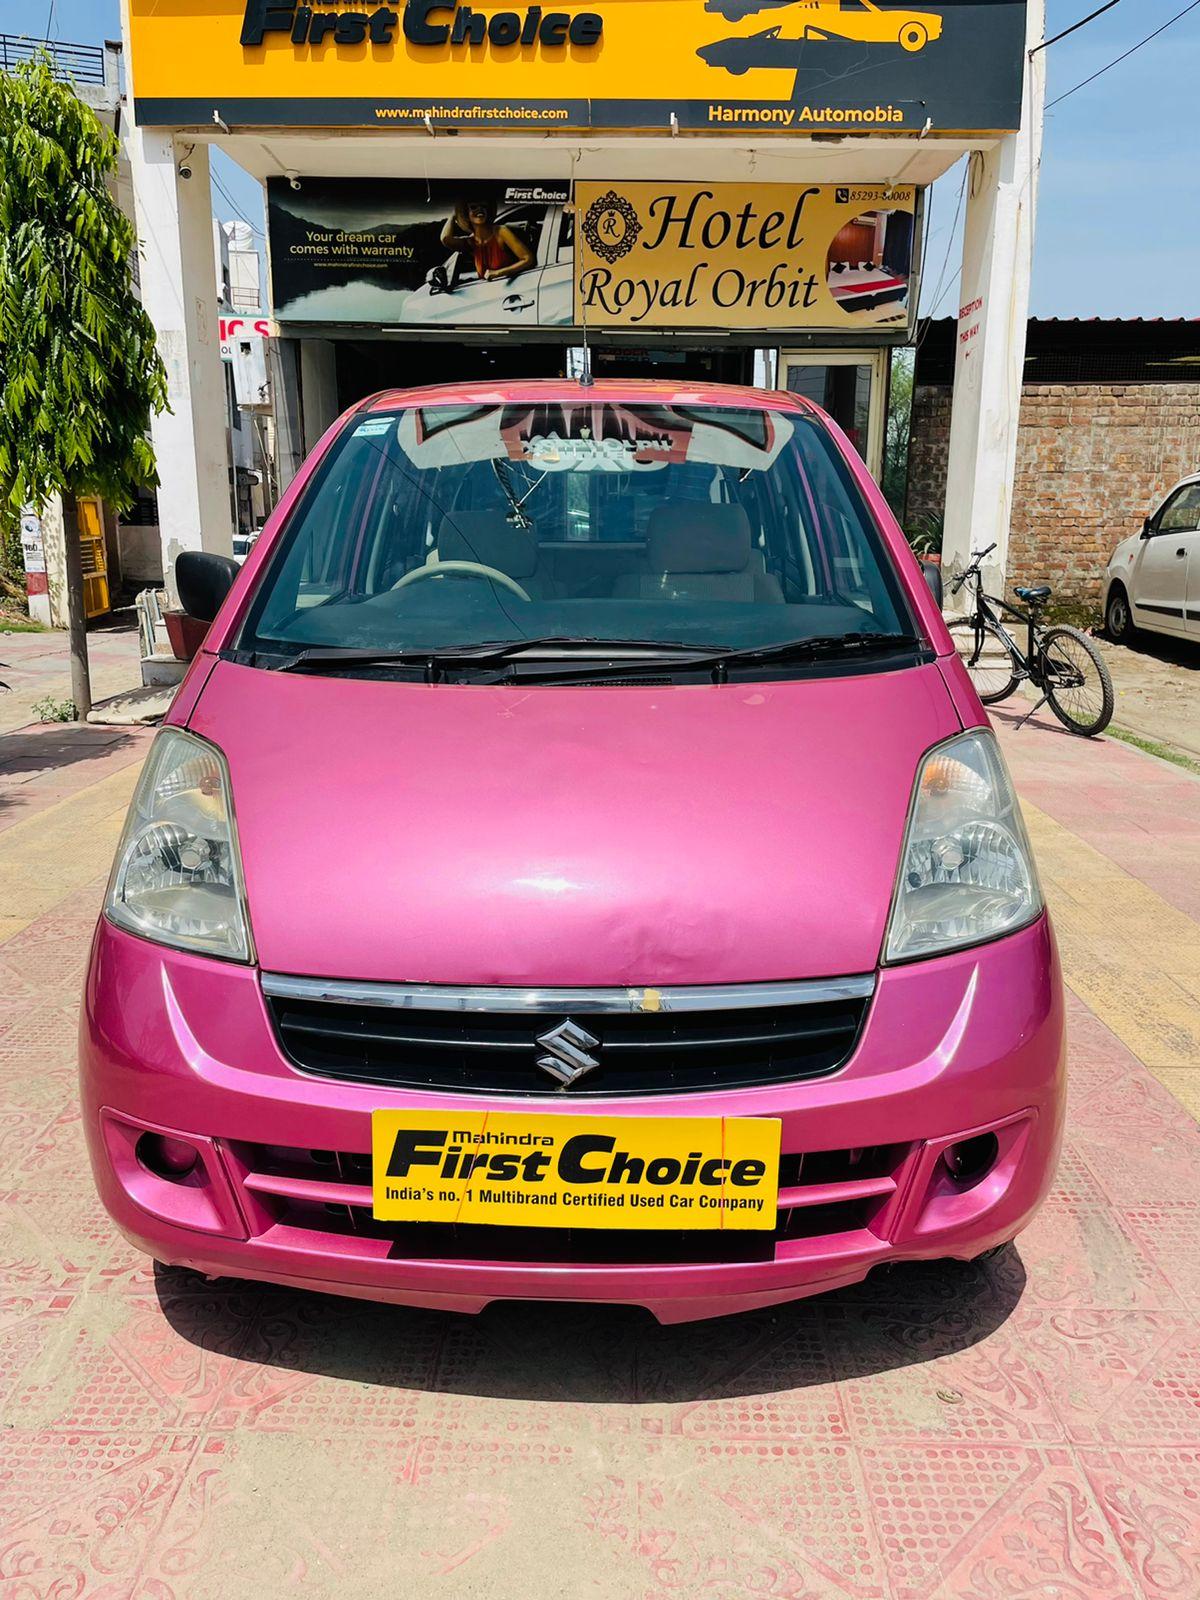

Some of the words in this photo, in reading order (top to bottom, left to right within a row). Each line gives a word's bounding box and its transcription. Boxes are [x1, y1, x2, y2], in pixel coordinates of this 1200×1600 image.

[240, 0, 399, 46] First
[403, 0, 603, 46] Choice
[375, 106, 569, 119] www.mahindrafirstchoice.com
[708, 105, 795, 125] Harmony
[799, 105, 903, 122] Automobia
[505, 187, 532, 199] First
[533, 187, 567, 200] Choice
[602, 217, 621, 238] R
[642, 187, 820, 250] Hotel
[306, 231, 333, 242] Your
[336, 232, 375, 242] dream
[378, 233, 397, 243] car
[290, 244, 329, 254] comes
[332, 244, 358, 255] with
[361, 246, 414, 258] warranty
[579, 262, 708, 322] Royal
[712, 263, 819, 308] Orbit
[453, 1131, 554, 1146] Mahindra
[385, 1129, 552, 1183] First
[557, 1134, 766, 1187] Choice
[386, 1187, 434, 1201] India's
[439, 1191, 460, 1202] no.
[466, 1190, 473, 1202] 1
[479, 1190, 557, 1206] Multibrand
[562, 1193, 624, 1208] Certified
[630, 1195, 664, 1208] Used
[669, 1196, 694, 1209] Car
[699, 1196, 764, 1212] Company
